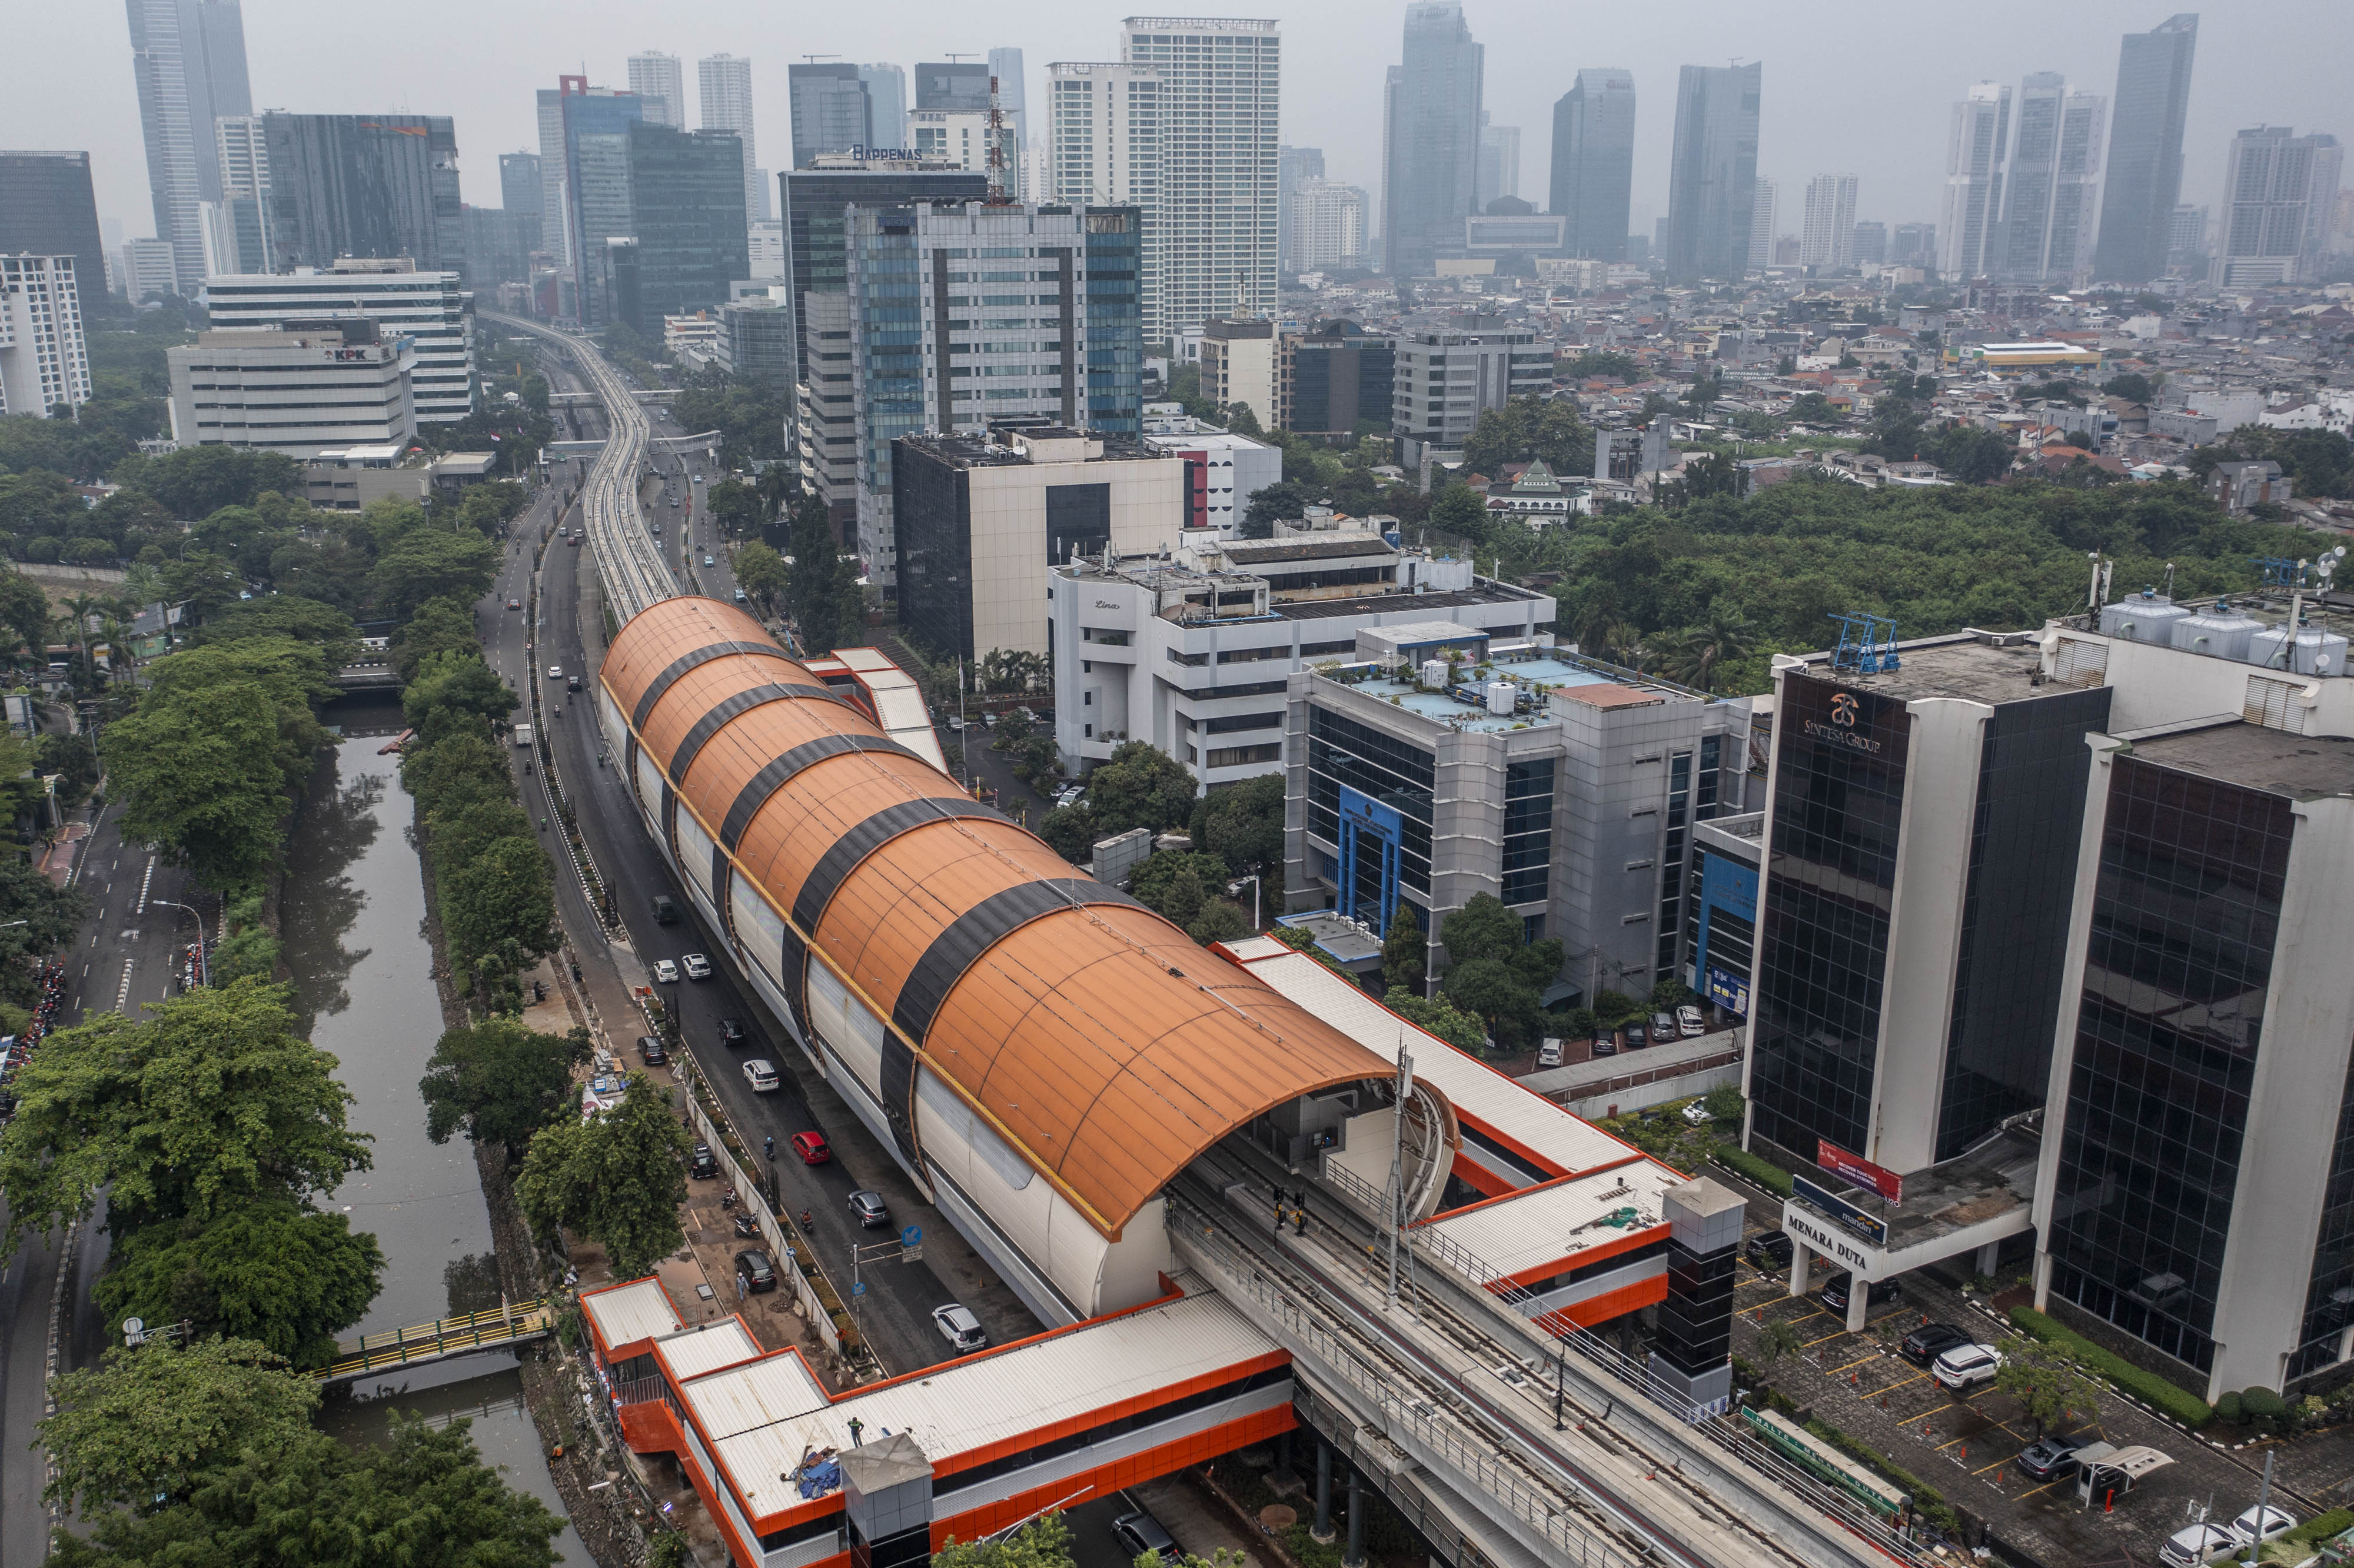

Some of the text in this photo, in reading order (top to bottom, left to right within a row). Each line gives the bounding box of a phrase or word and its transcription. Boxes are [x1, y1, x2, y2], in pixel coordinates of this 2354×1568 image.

[853, 144, 922, 161] BAPPENAS
[334, 349, 367, 360] KPK
[1804, 720, 1881, 753] SINTESA GROUP
[1838, 1161, 1857, 1173] RECOVER
[1838, 1167, 1857, 1178] RECOVER
[1842, 1213, 1871, 1234] mandiri
[1788, 1214, 1867, 1270] MENARA DUTA
[1755, 1416, 1790, 1441] HALTE
[1803, 1446, 1847, 1479] MENARA
[1854, 1480, 1884, 1502] DUTA
